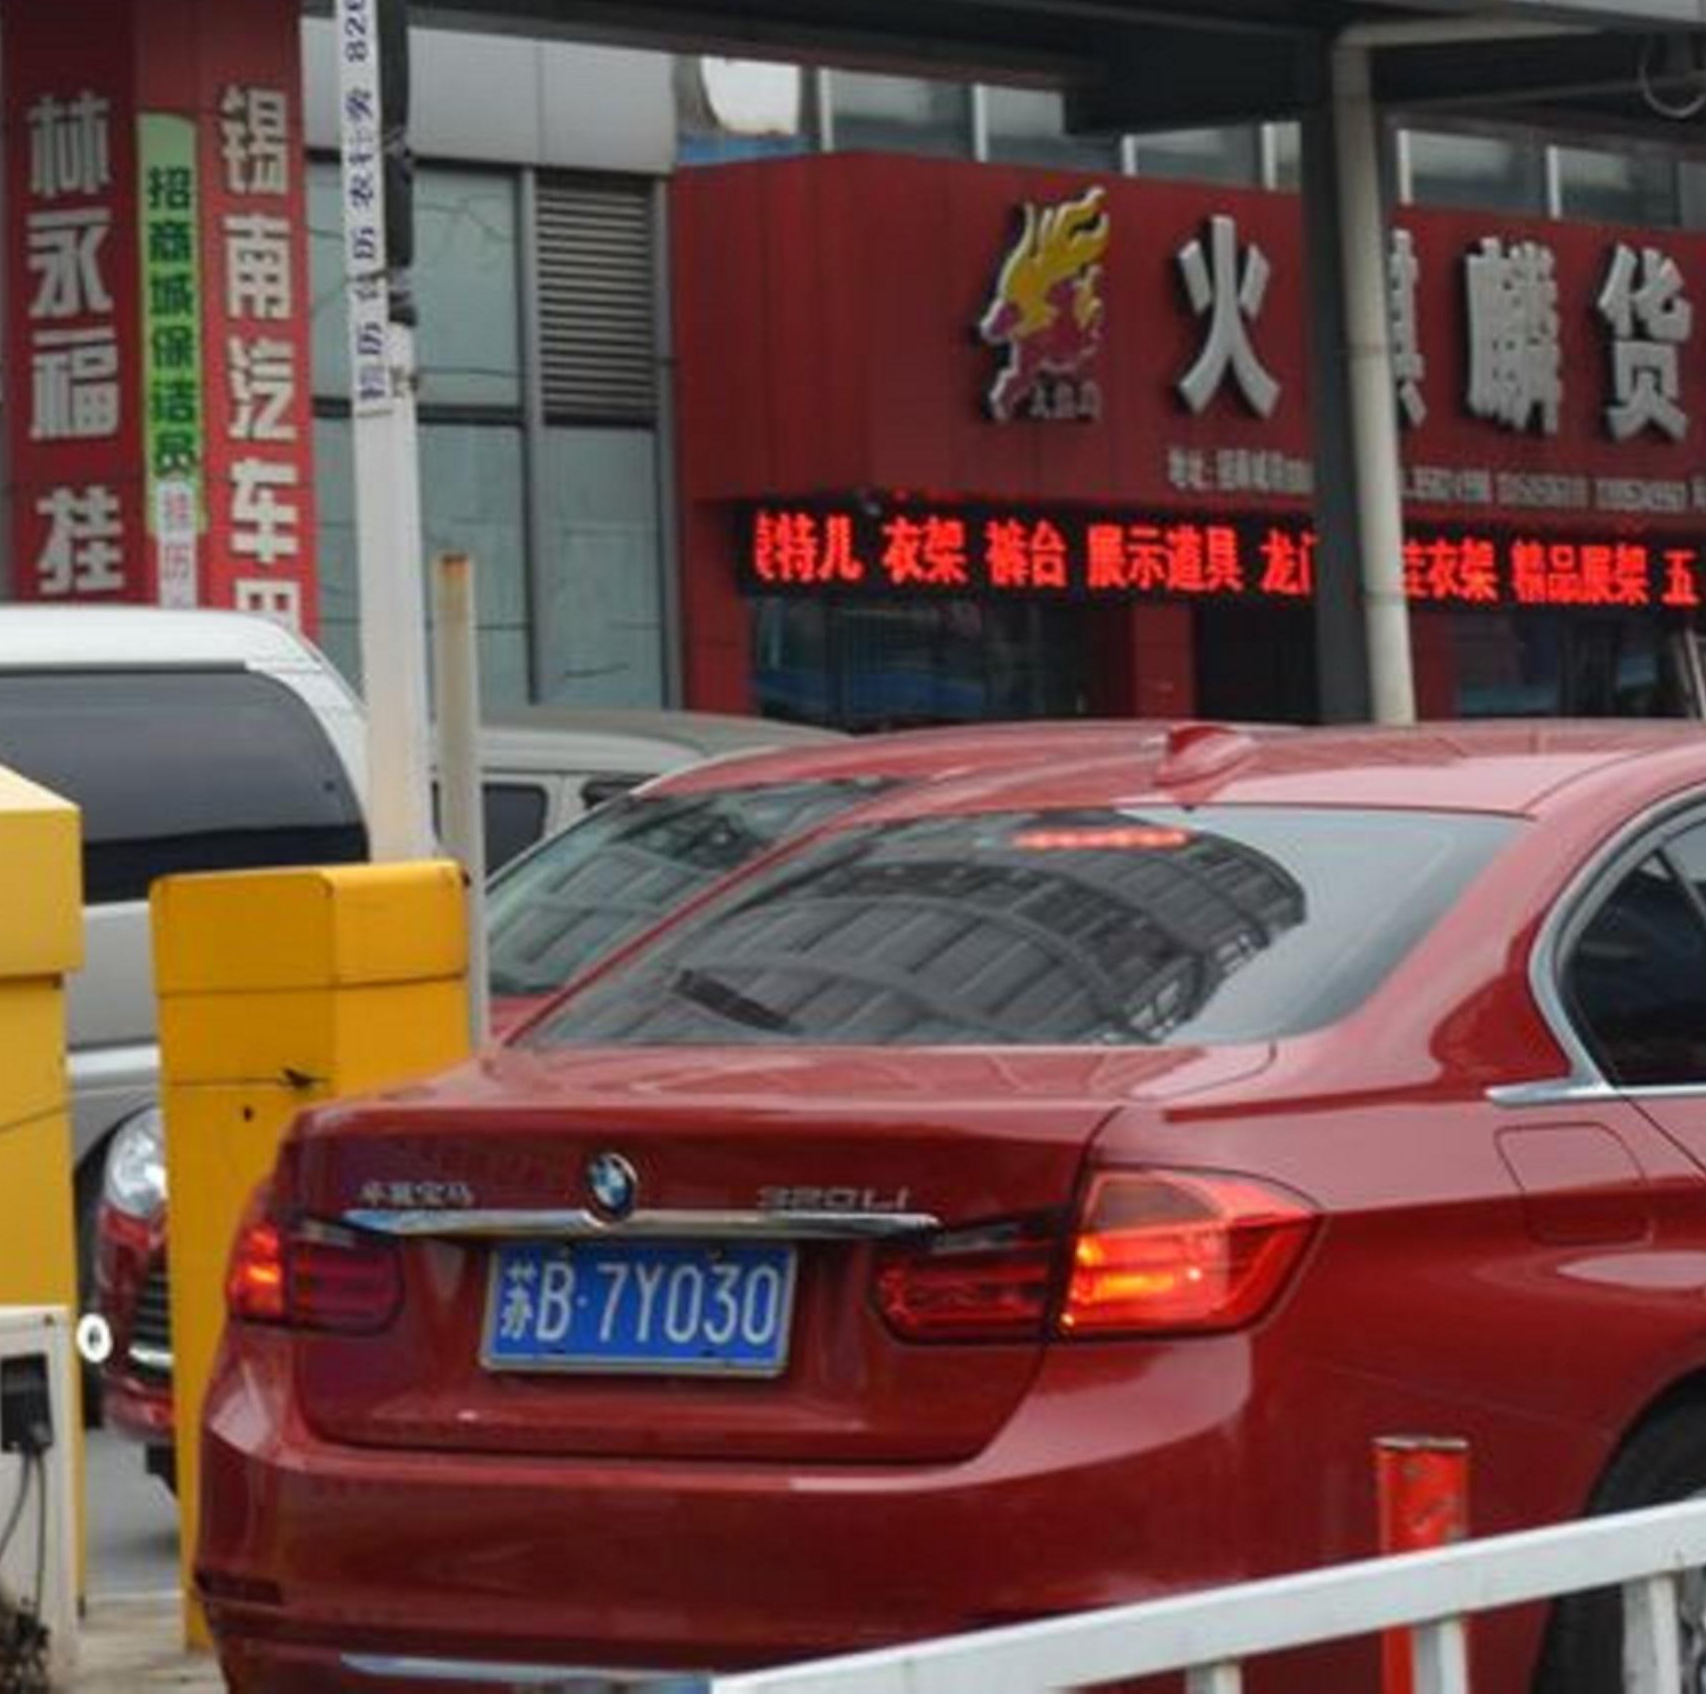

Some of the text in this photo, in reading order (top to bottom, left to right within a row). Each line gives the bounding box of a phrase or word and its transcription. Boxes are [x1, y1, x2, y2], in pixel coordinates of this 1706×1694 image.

[26, 90, 119, 441] 林永福
[881, 514, 968, 586] 衣架
[1087, 522, 1243, 593] 展示道具
[1510, 536, 1650, 605] 精品展架
[1663, 549, 1700, 606] 五
